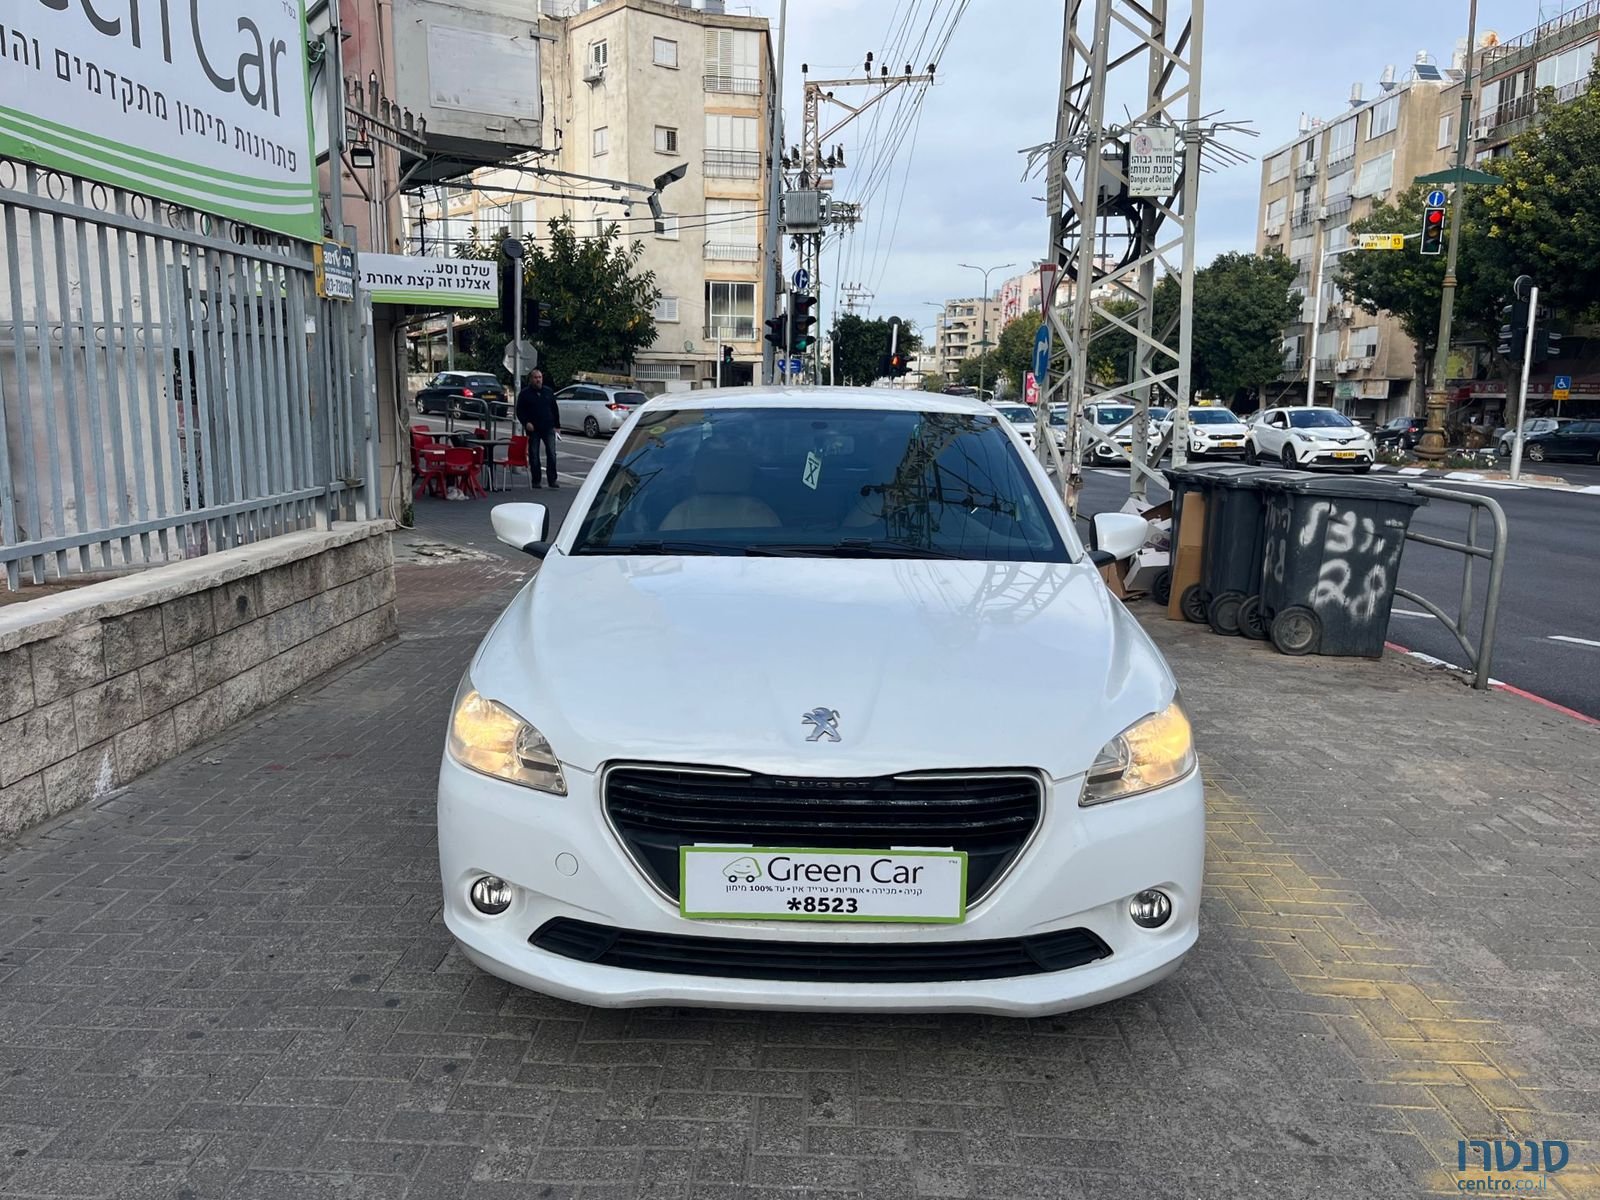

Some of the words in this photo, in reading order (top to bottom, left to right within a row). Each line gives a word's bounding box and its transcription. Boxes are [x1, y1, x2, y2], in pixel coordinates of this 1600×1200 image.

[189, 0, 287, 117] Car
[54, 48, 168, 120] מתקדמים
[176, 101, 227, 144] מימון
[235, 126, 297, 172] פתרונות
[1153, 166, 1172, 174] סכנת
[1130, 175, 1148, 184] Danger
[462, 263, 490, 276] שלם
[366, 272, 403, 285] אחרת
[407, 275, 434, 290] קצת
[438, 277, 452, 288] זה
[457, 276, 491, 290] אצלנו
[767, 856, 861, 884] Green
[870, 858, 924, 884] Car
[725, 884, 747, 893] מימון
[749, 885, 773, 893] 100%
[774, 885, 785, 893] עד
[792, 885, 805, 894] אין
[835, 886, 865, 894] אחריות
[871, 887, 897, 895] מכירה
[903, 887, 923, 896] קניה
